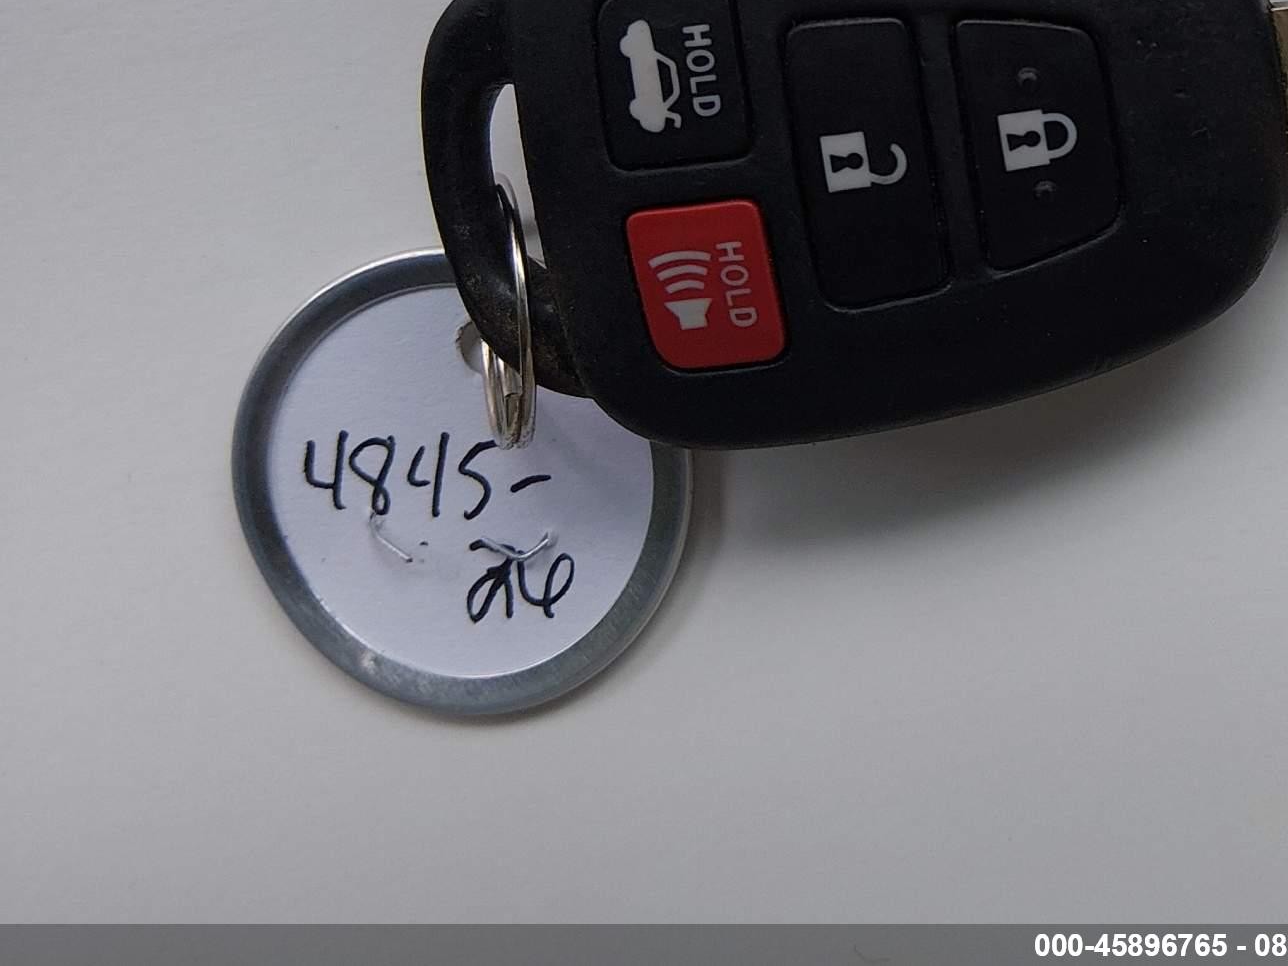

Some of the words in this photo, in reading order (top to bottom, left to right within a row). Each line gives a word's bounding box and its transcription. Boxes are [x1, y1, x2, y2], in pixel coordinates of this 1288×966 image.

[682, 23, 722, 117] HOLD
[715, 241, 758, 328] HOLD
[303, 430, 552, 520] 4845-
